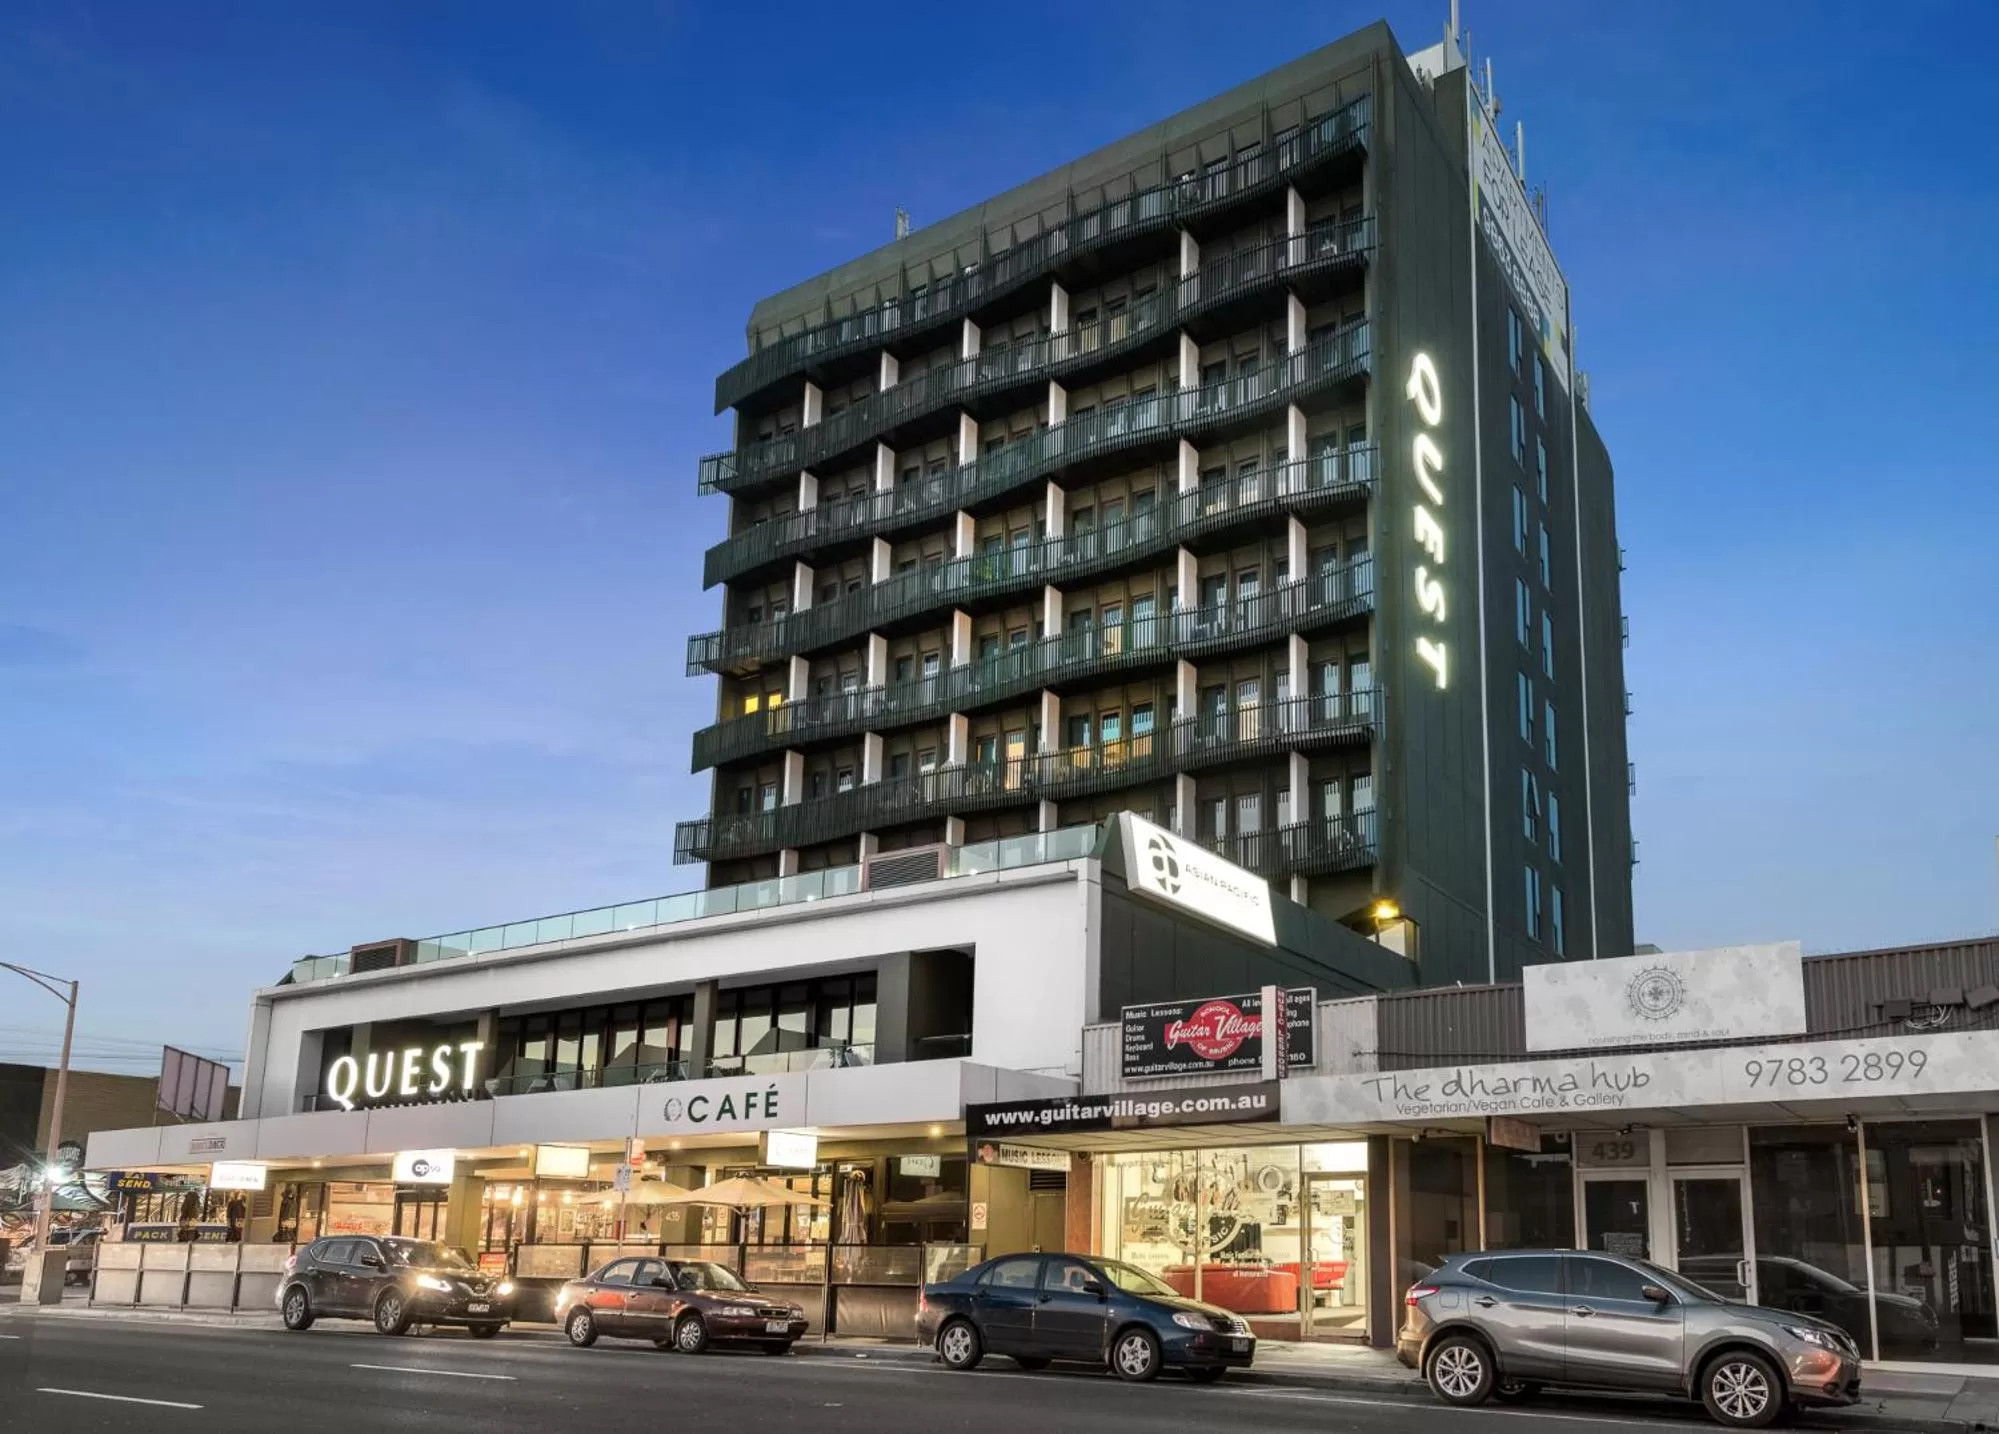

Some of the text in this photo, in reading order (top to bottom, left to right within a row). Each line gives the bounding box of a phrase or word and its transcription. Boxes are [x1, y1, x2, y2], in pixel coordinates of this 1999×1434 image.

[1483, 158, 1552, 316] FOR LEASE
[1407, 353, 1446, 690] QUEST
[1125, 1010, 1147, 1019] Music
[1167, 1014, 1263, 1050] Guitar Village
[328, 1042, 484, 1111] QUEST
[1228, 1057, 1256, 1067] phone
[1745, 1050, 1928, 1088] 9783 2899
[1361, 1062, 1651, 1103] The dharma hub
[687, 1083, 779, 1123] CAFÉ
[985, 1093, 1267, 1127] www.guitarvillage.com.au
[1396, 1098, 1517, 1117] Vegetarian/Vegan
[1559, 1096, 1570, 1108] &
[1573, 1092, 1625, 1107] Gallery
[1001, 1147, 1028, 1163] MUSIC
[1591, 1140, 1635, 1161] 439
[116, 1177, 152, 1189] SEND
[133, 1230, 169, 1240] PACK
